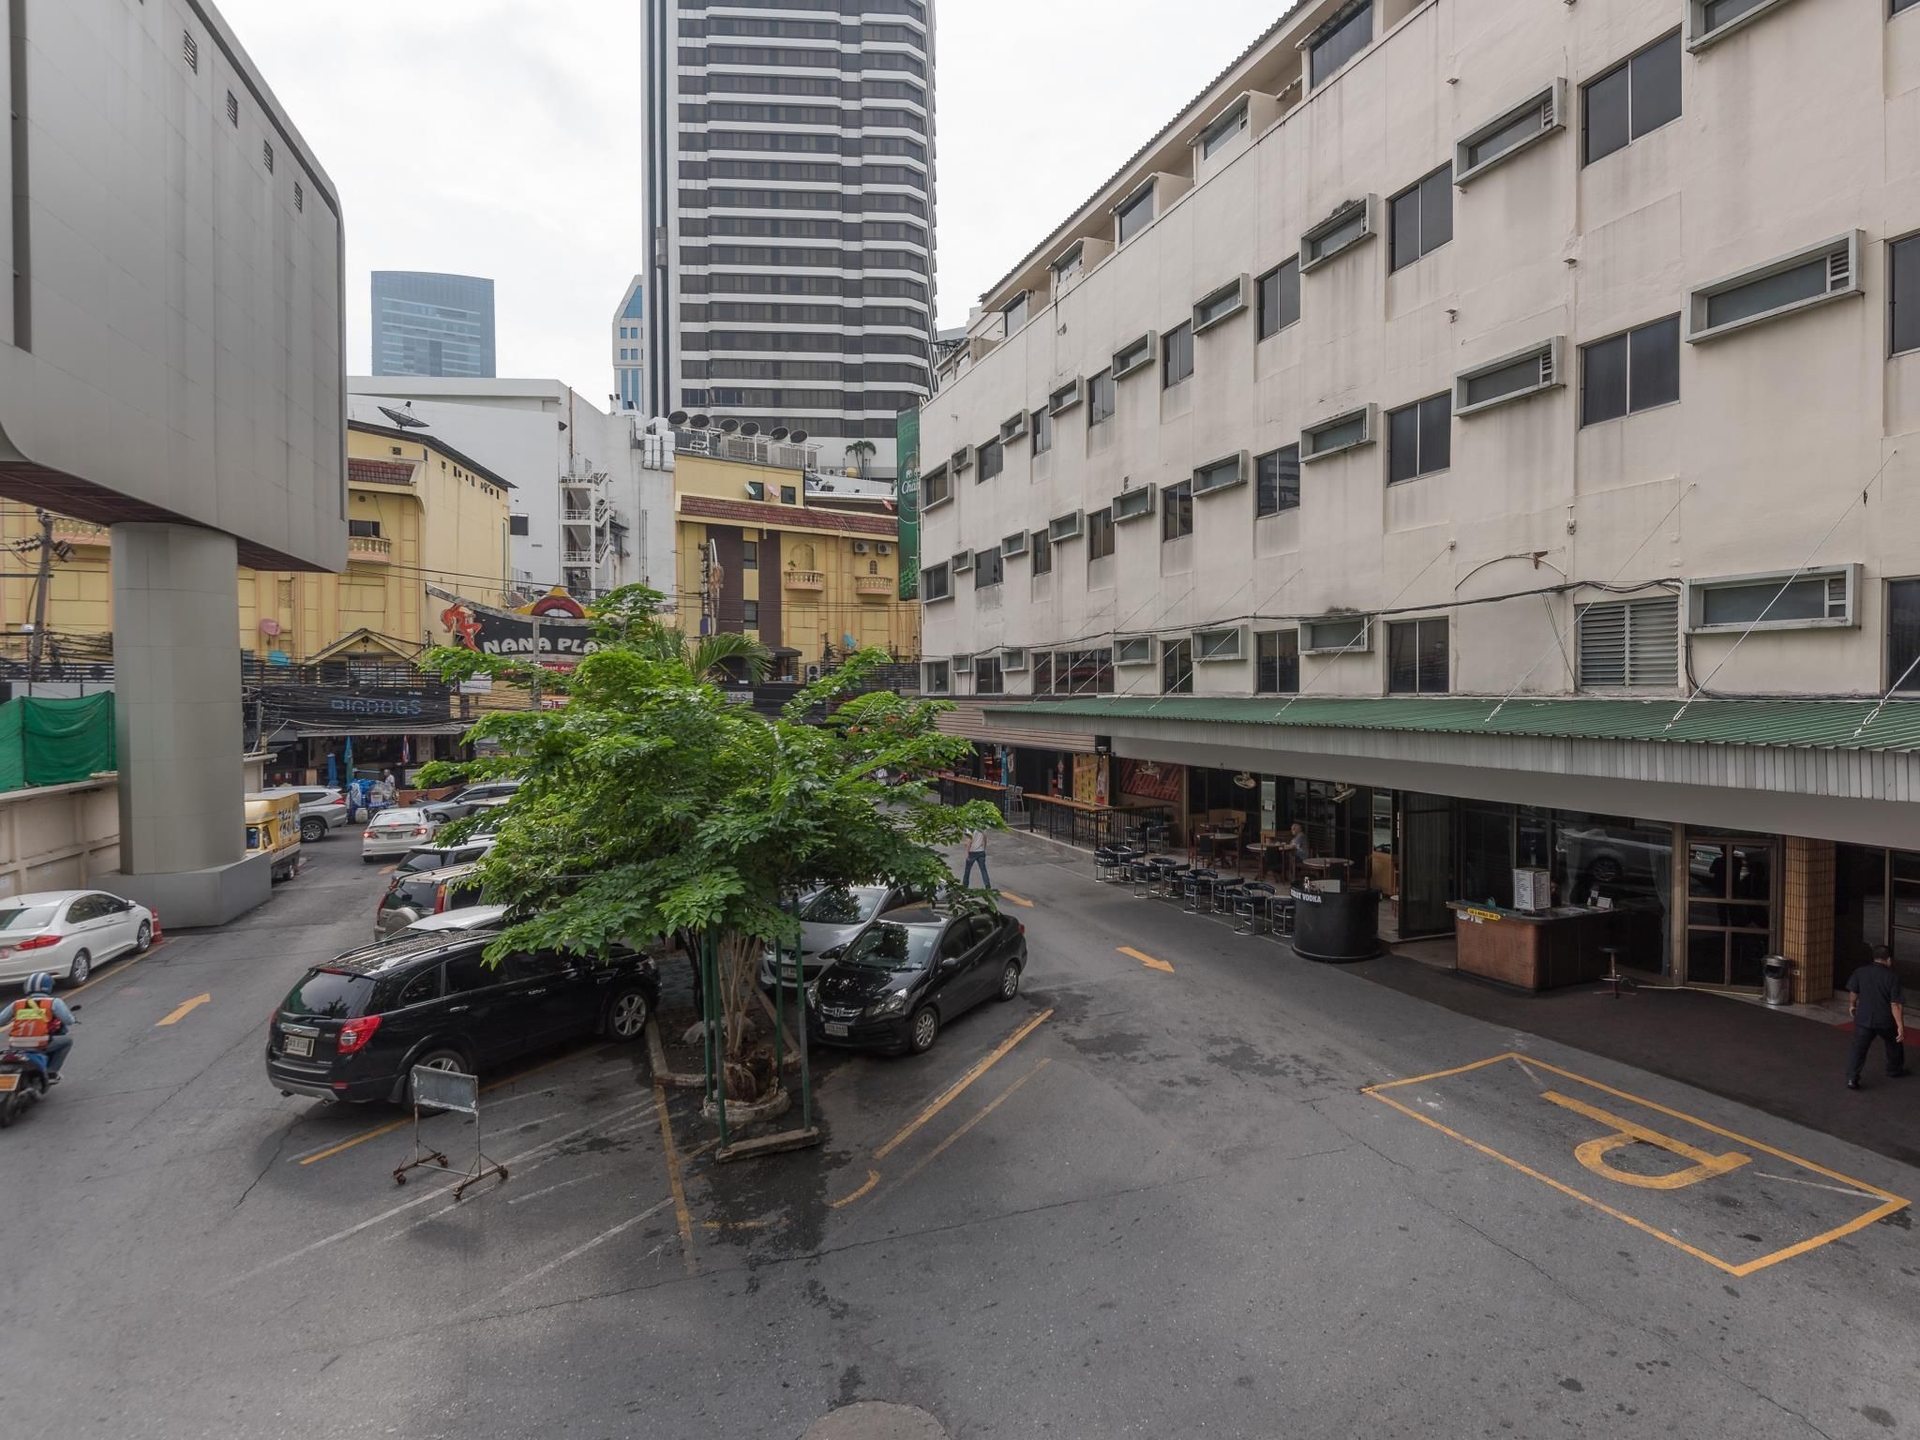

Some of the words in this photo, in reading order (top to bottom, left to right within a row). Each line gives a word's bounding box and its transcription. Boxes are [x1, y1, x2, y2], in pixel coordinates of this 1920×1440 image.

[483, 637, 552, 655] NANA
[557, 637, 600, 655] PLA
[17, 1020, 36, 1036] 11
[1540, 1091, 1753, 1190] P
